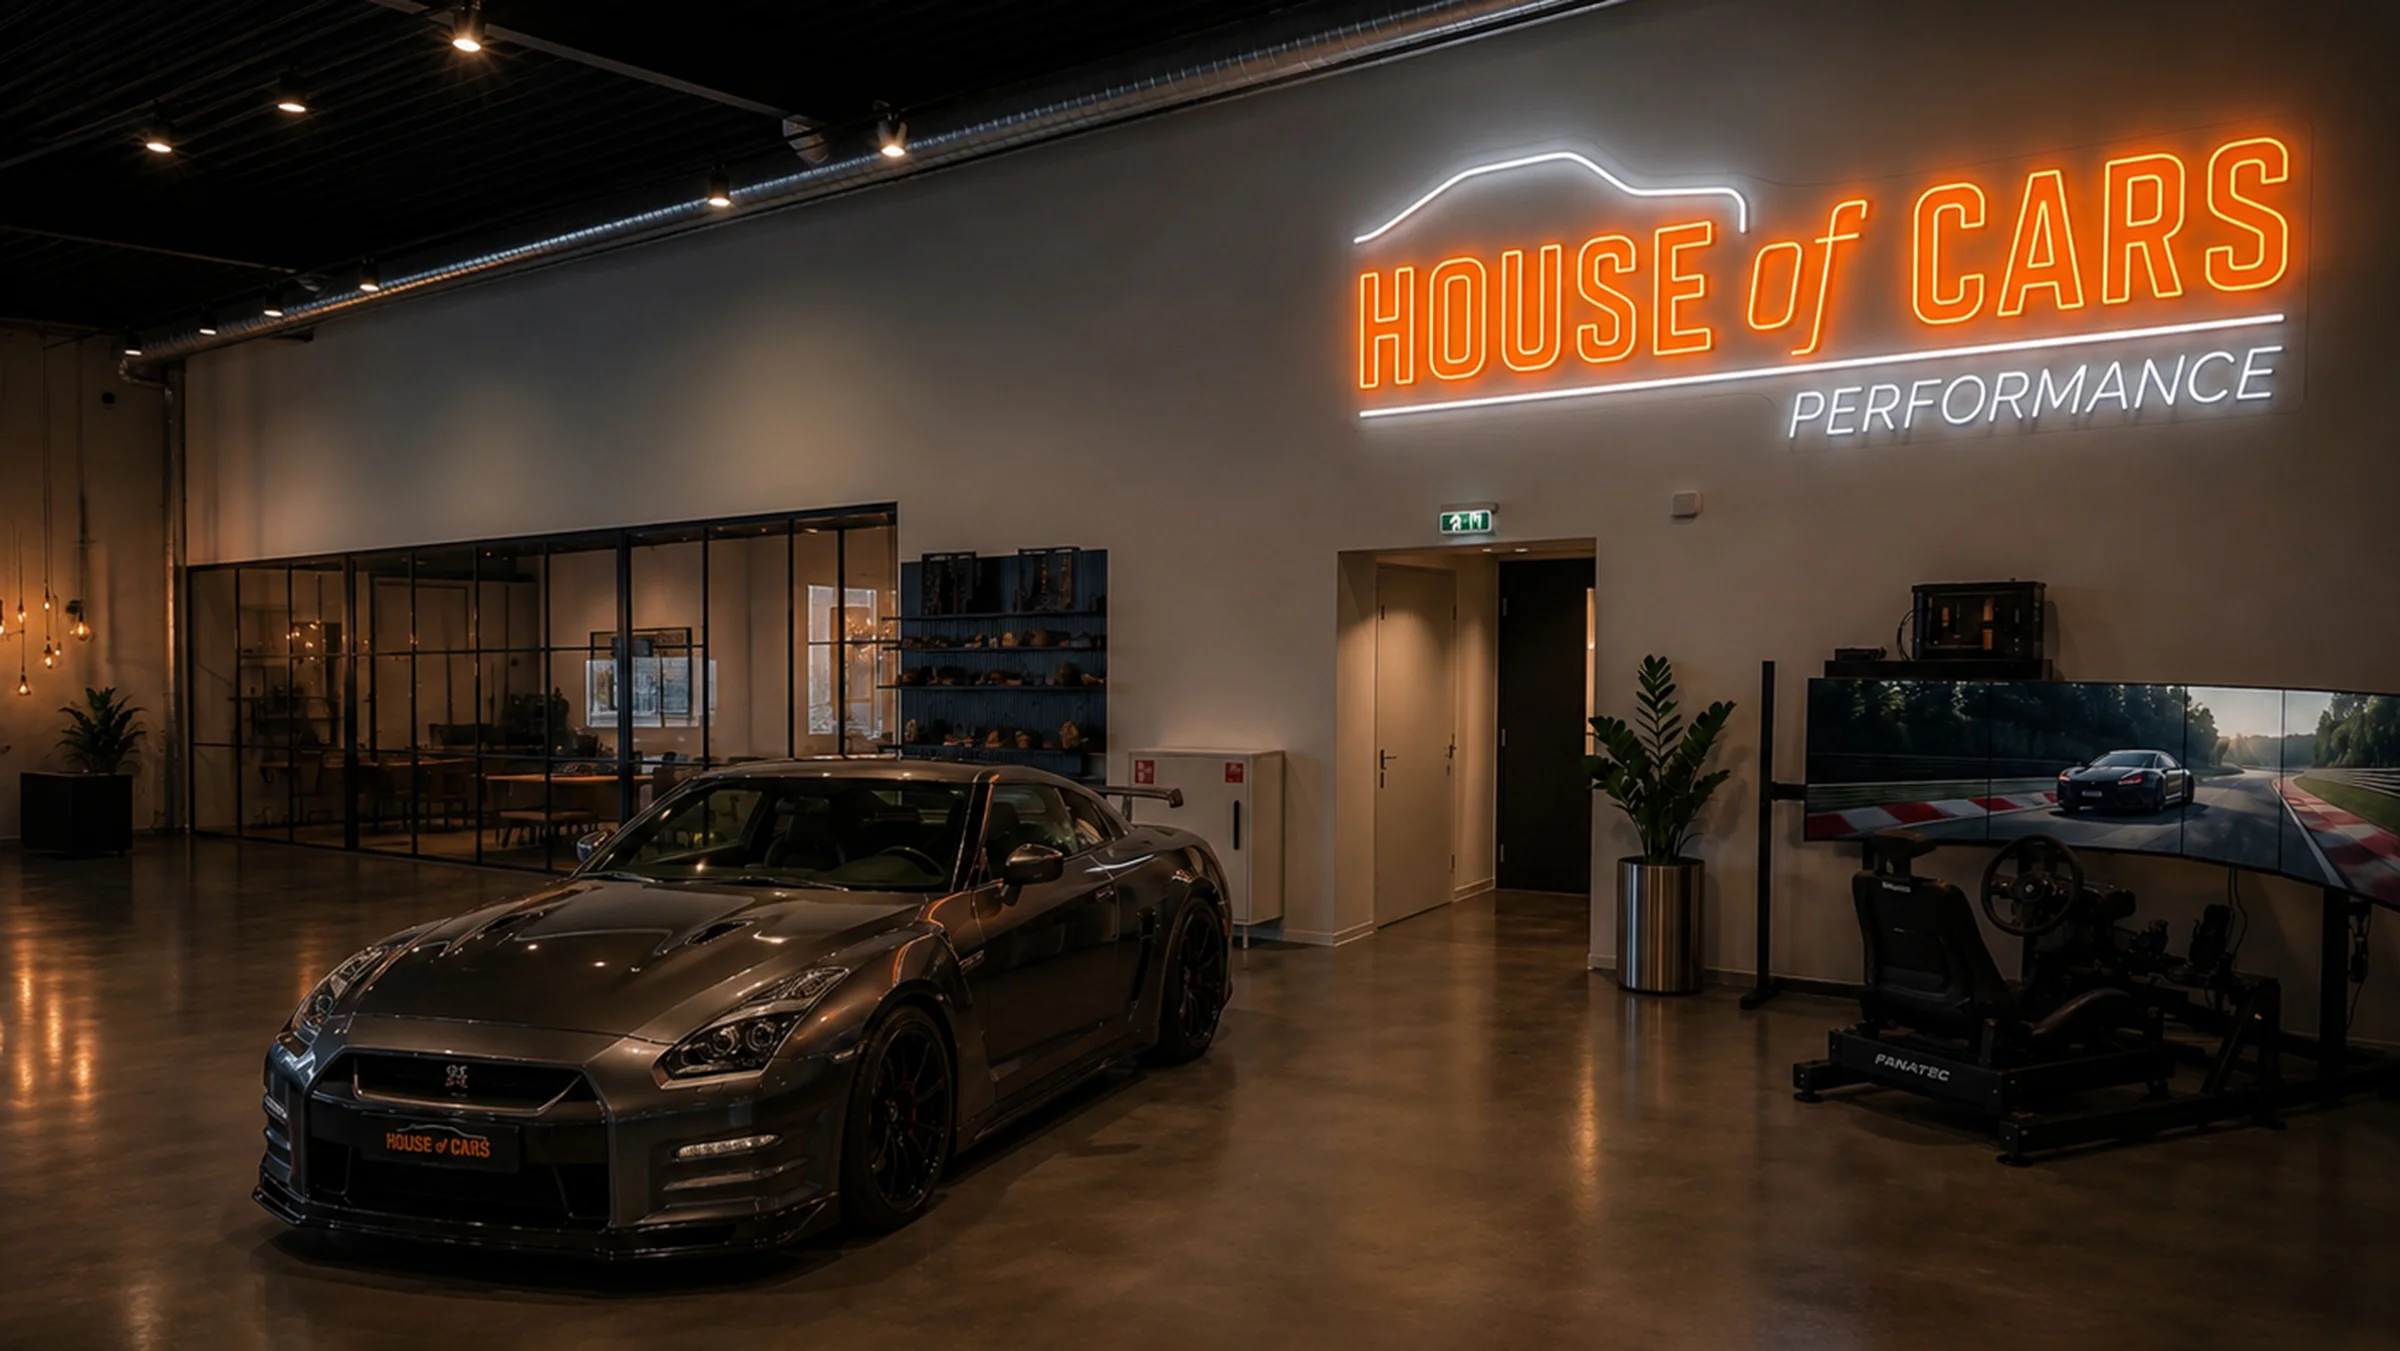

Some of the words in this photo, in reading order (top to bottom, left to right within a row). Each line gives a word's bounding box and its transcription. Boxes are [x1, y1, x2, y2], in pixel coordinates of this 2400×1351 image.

[1359, 221, 1713, 389] HOUSE
[1748, 199, 1868, 355] of
[1912, 137, 2289, 326] CARS
[1788, 345, 2283, 438] PERFORMANCE
[386, 1132, 432, 1153] HOUSE
[435, 1138, 449, 1154] of
[450, 1138, 491, 1158] CARS
